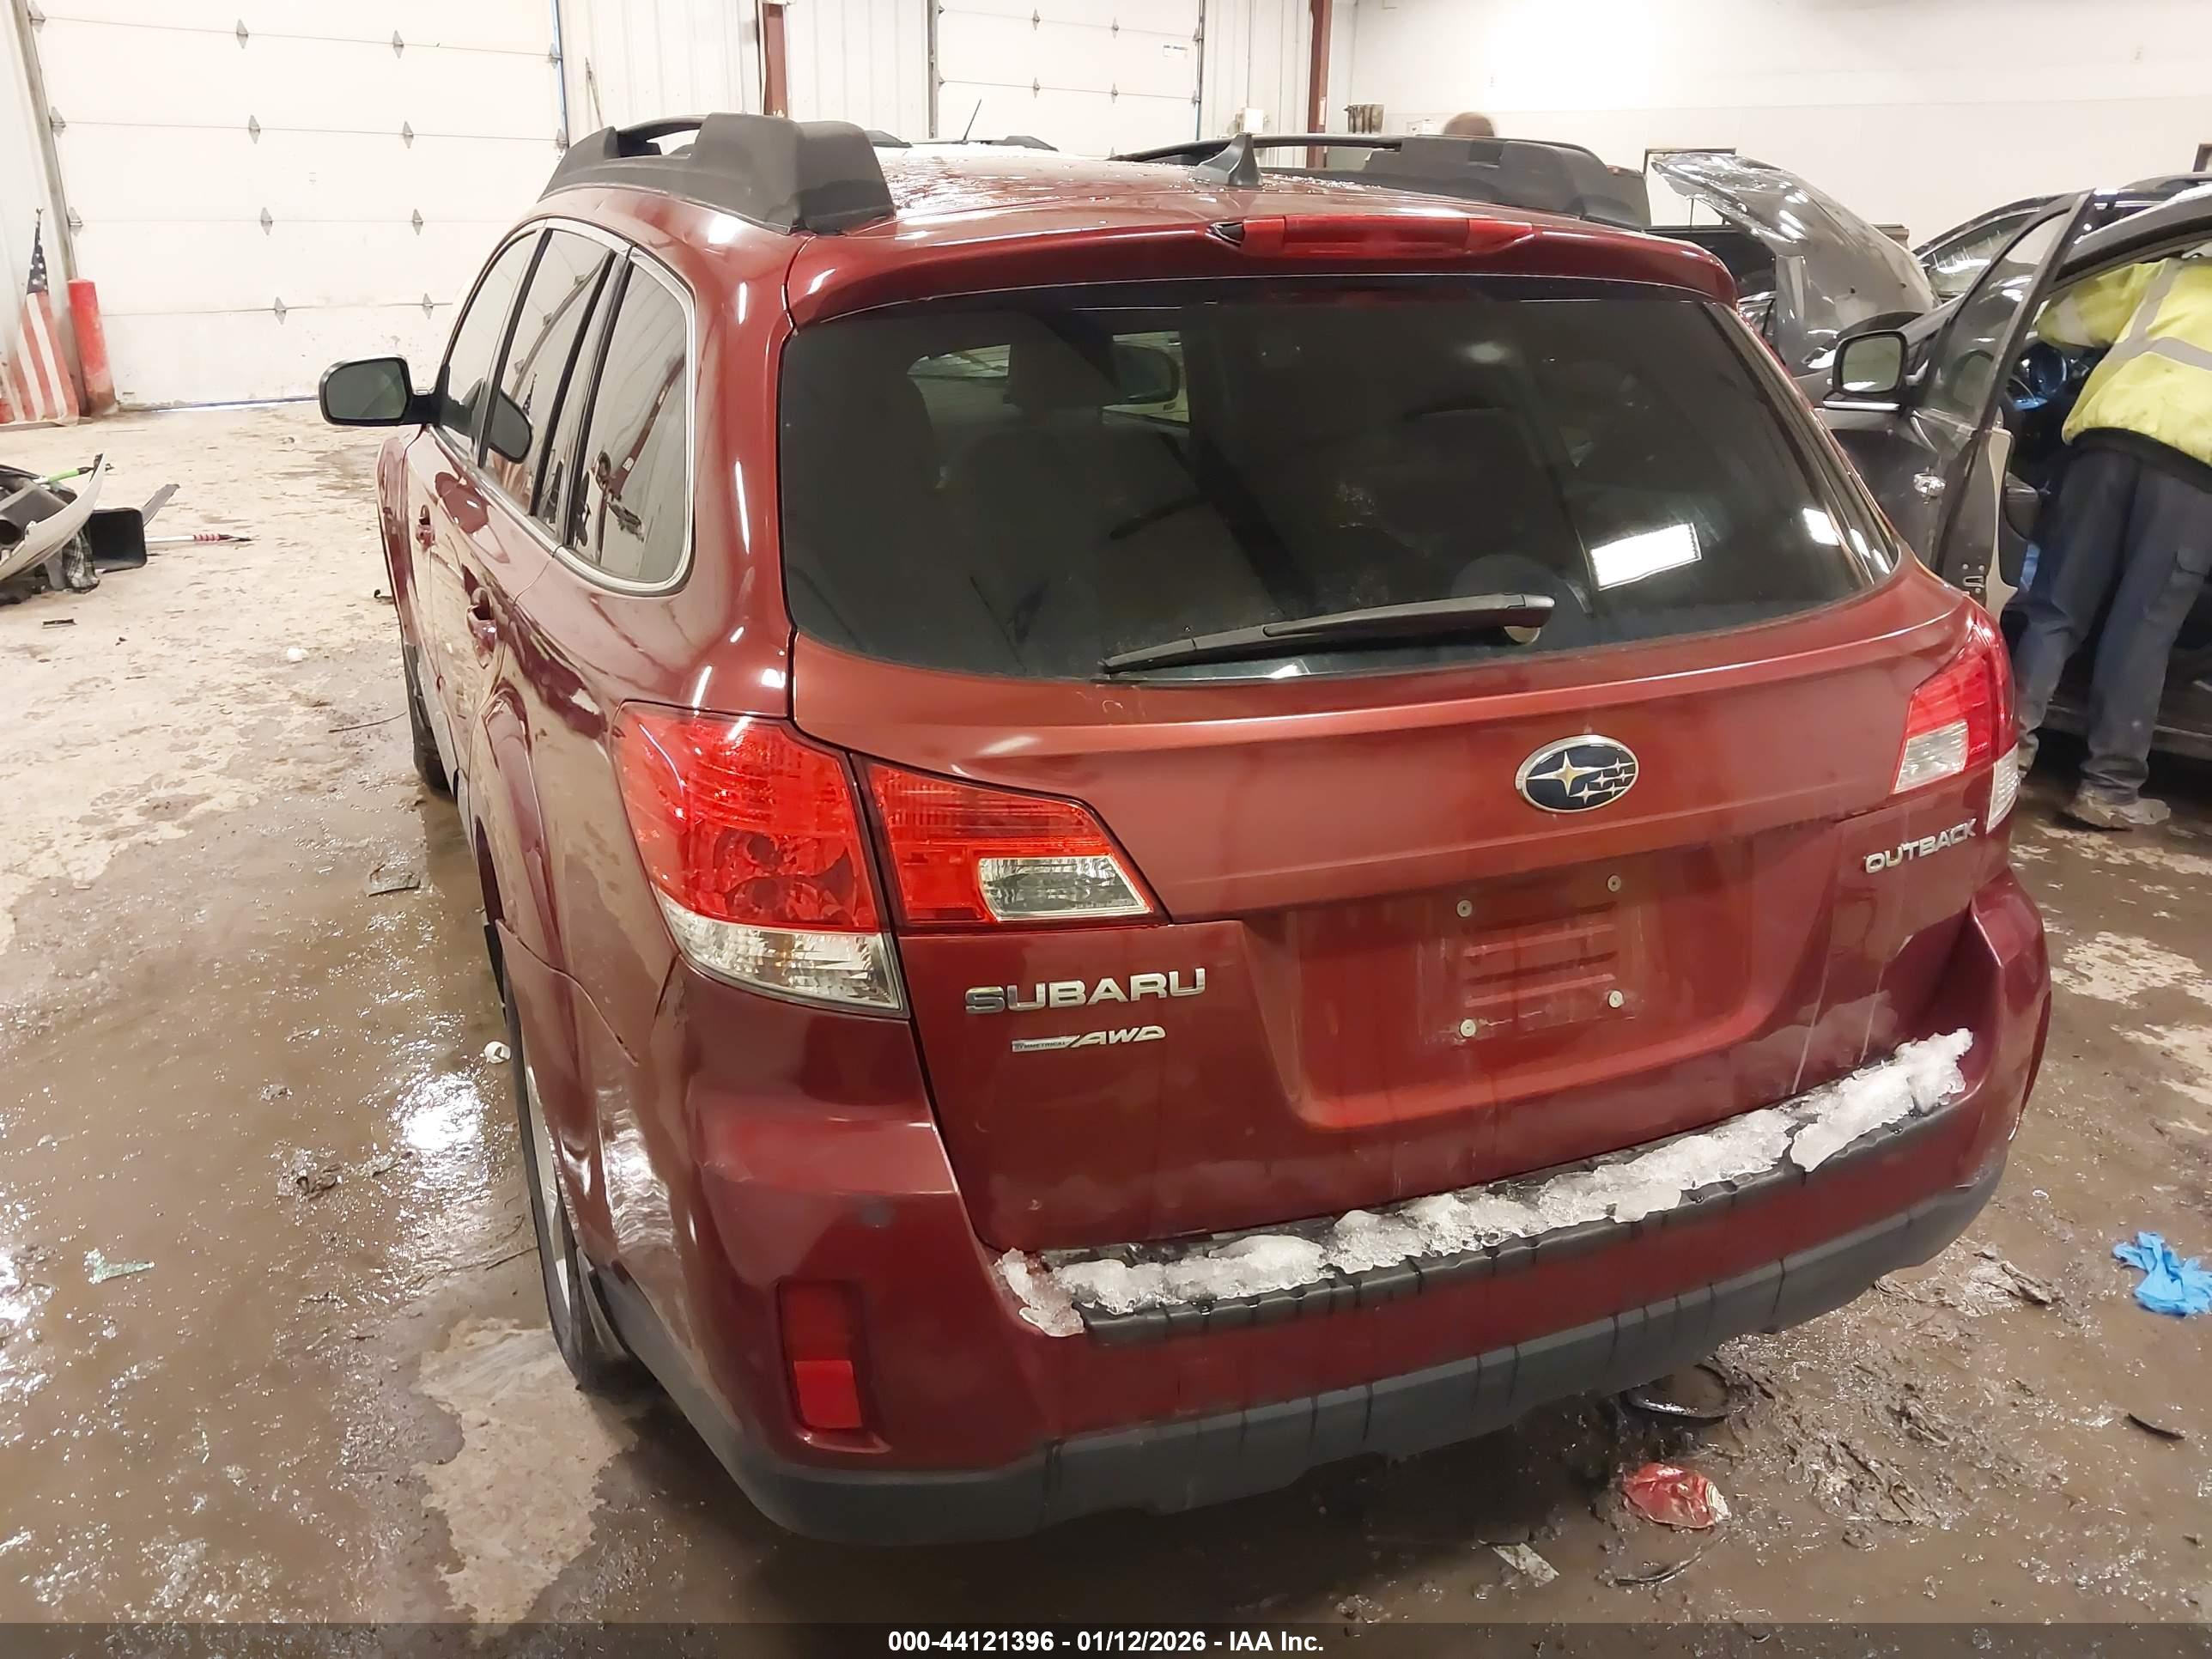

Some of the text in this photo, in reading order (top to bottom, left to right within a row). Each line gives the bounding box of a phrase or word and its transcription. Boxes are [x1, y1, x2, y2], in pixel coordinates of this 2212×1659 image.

[1865, 818, 1977, 873] OUTBACK
[965, 968, 1206, 1014] SUBARU
[1072, 1025, 1166, 1048] AWD
